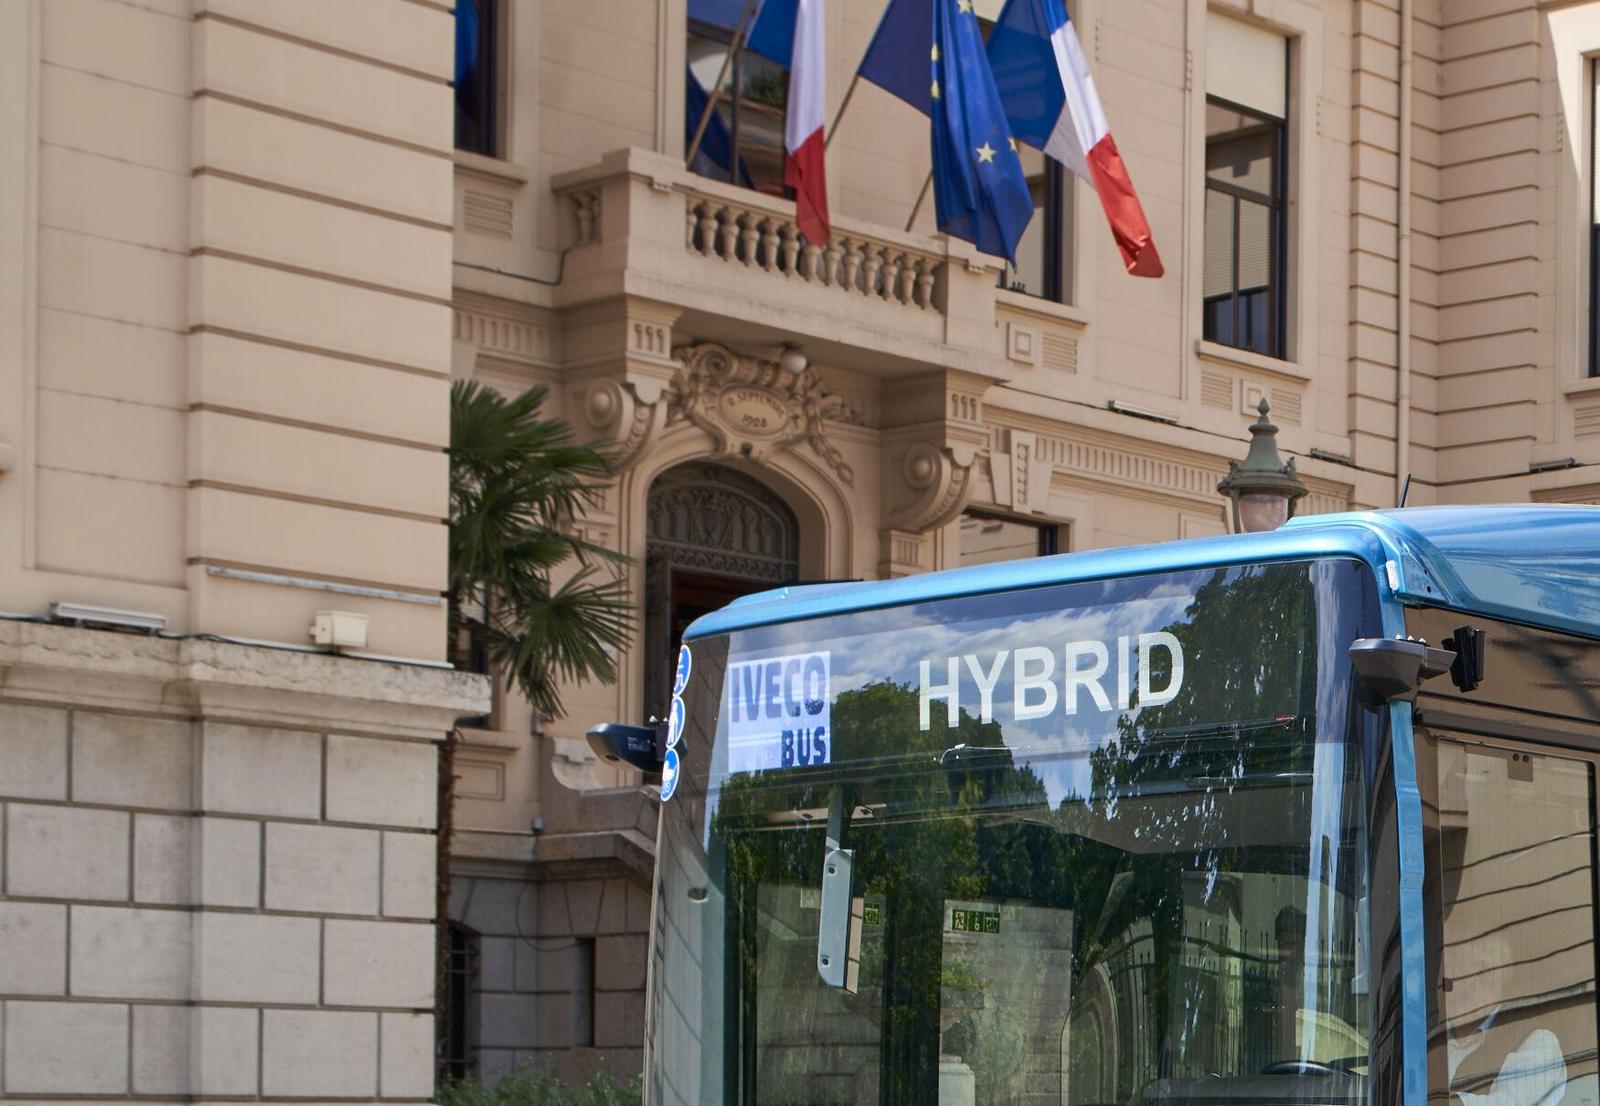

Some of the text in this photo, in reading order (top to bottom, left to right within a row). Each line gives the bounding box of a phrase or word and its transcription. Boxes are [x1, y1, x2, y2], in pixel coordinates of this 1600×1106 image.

[730, 655, 827, 723] IVECO
[919, 632, 1184, 731] HYBRID
[781, 725, 826, 769] BUS
